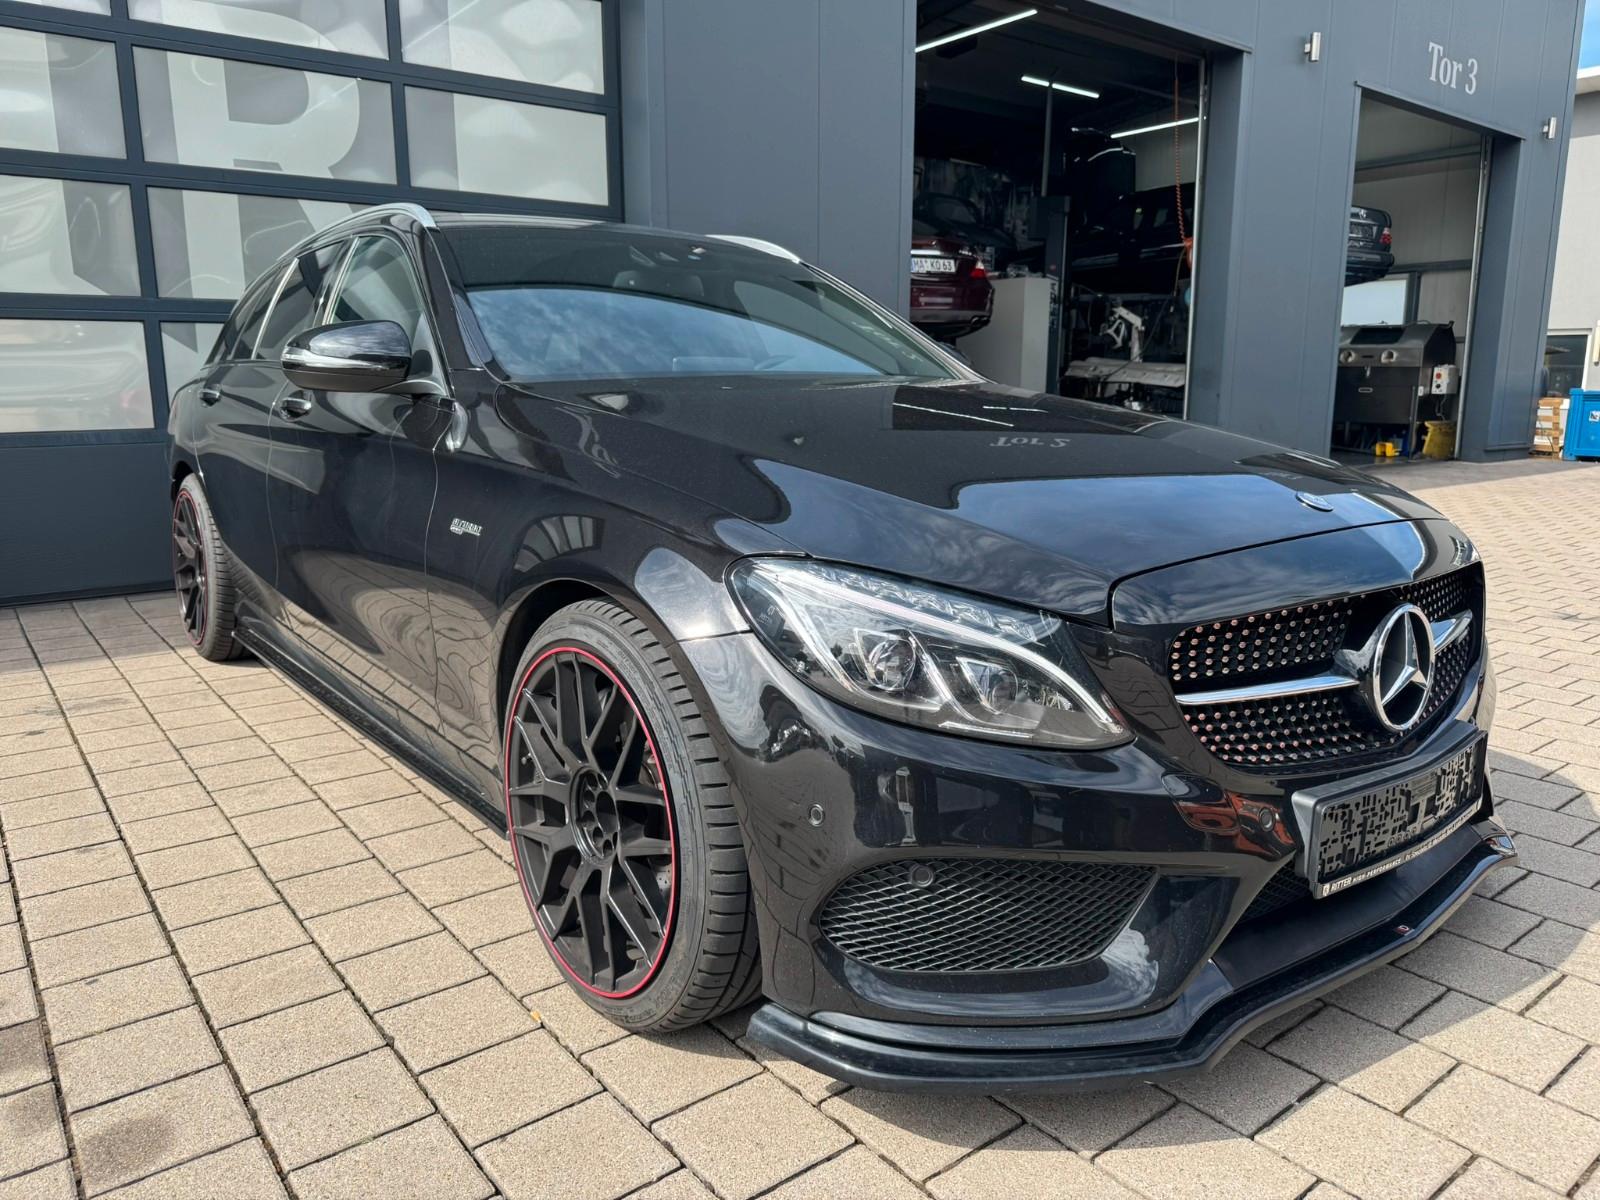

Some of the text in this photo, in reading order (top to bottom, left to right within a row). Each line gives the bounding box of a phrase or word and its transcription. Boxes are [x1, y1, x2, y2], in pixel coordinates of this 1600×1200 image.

[1428, 42, 1478, 95] Tor 3
[942, 261, 952, 271] 63
[1331, 876, 1352, 892] RITTER
